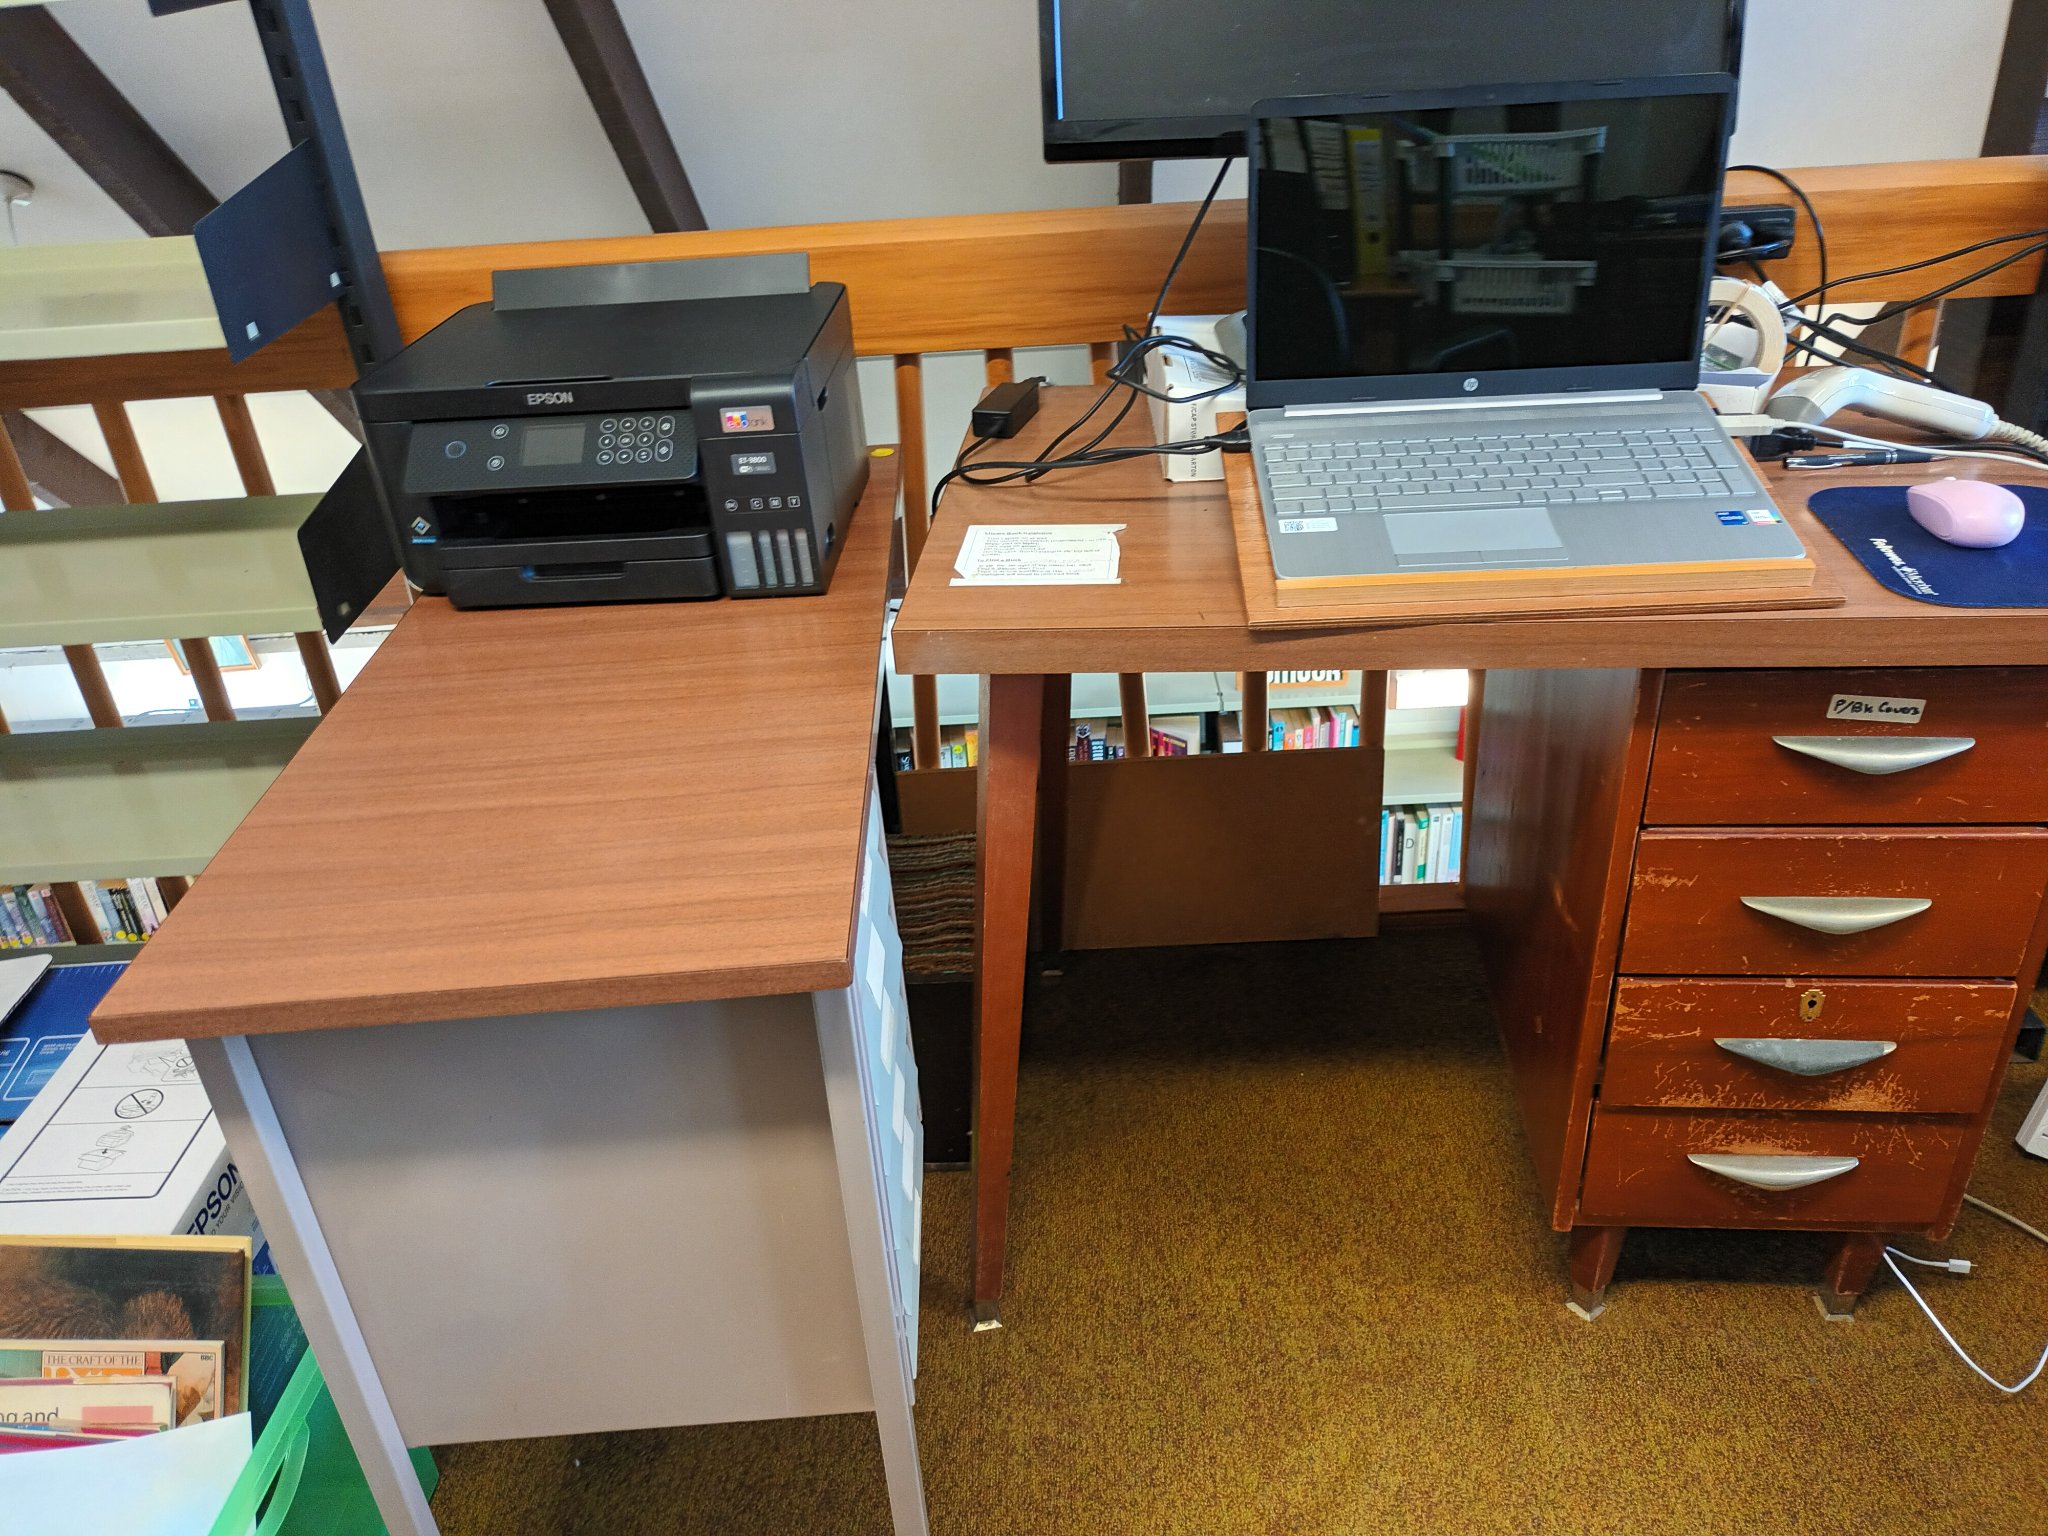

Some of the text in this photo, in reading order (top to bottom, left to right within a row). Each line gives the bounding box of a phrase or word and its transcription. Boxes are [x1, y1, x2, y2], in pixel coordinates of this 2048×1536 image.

[527, 391, 574, 405] EPSON
[216, 1180, 244, 1228] YOUR VISIO
[47, 1354, 142, 1366] THE CRAFT OF THE
